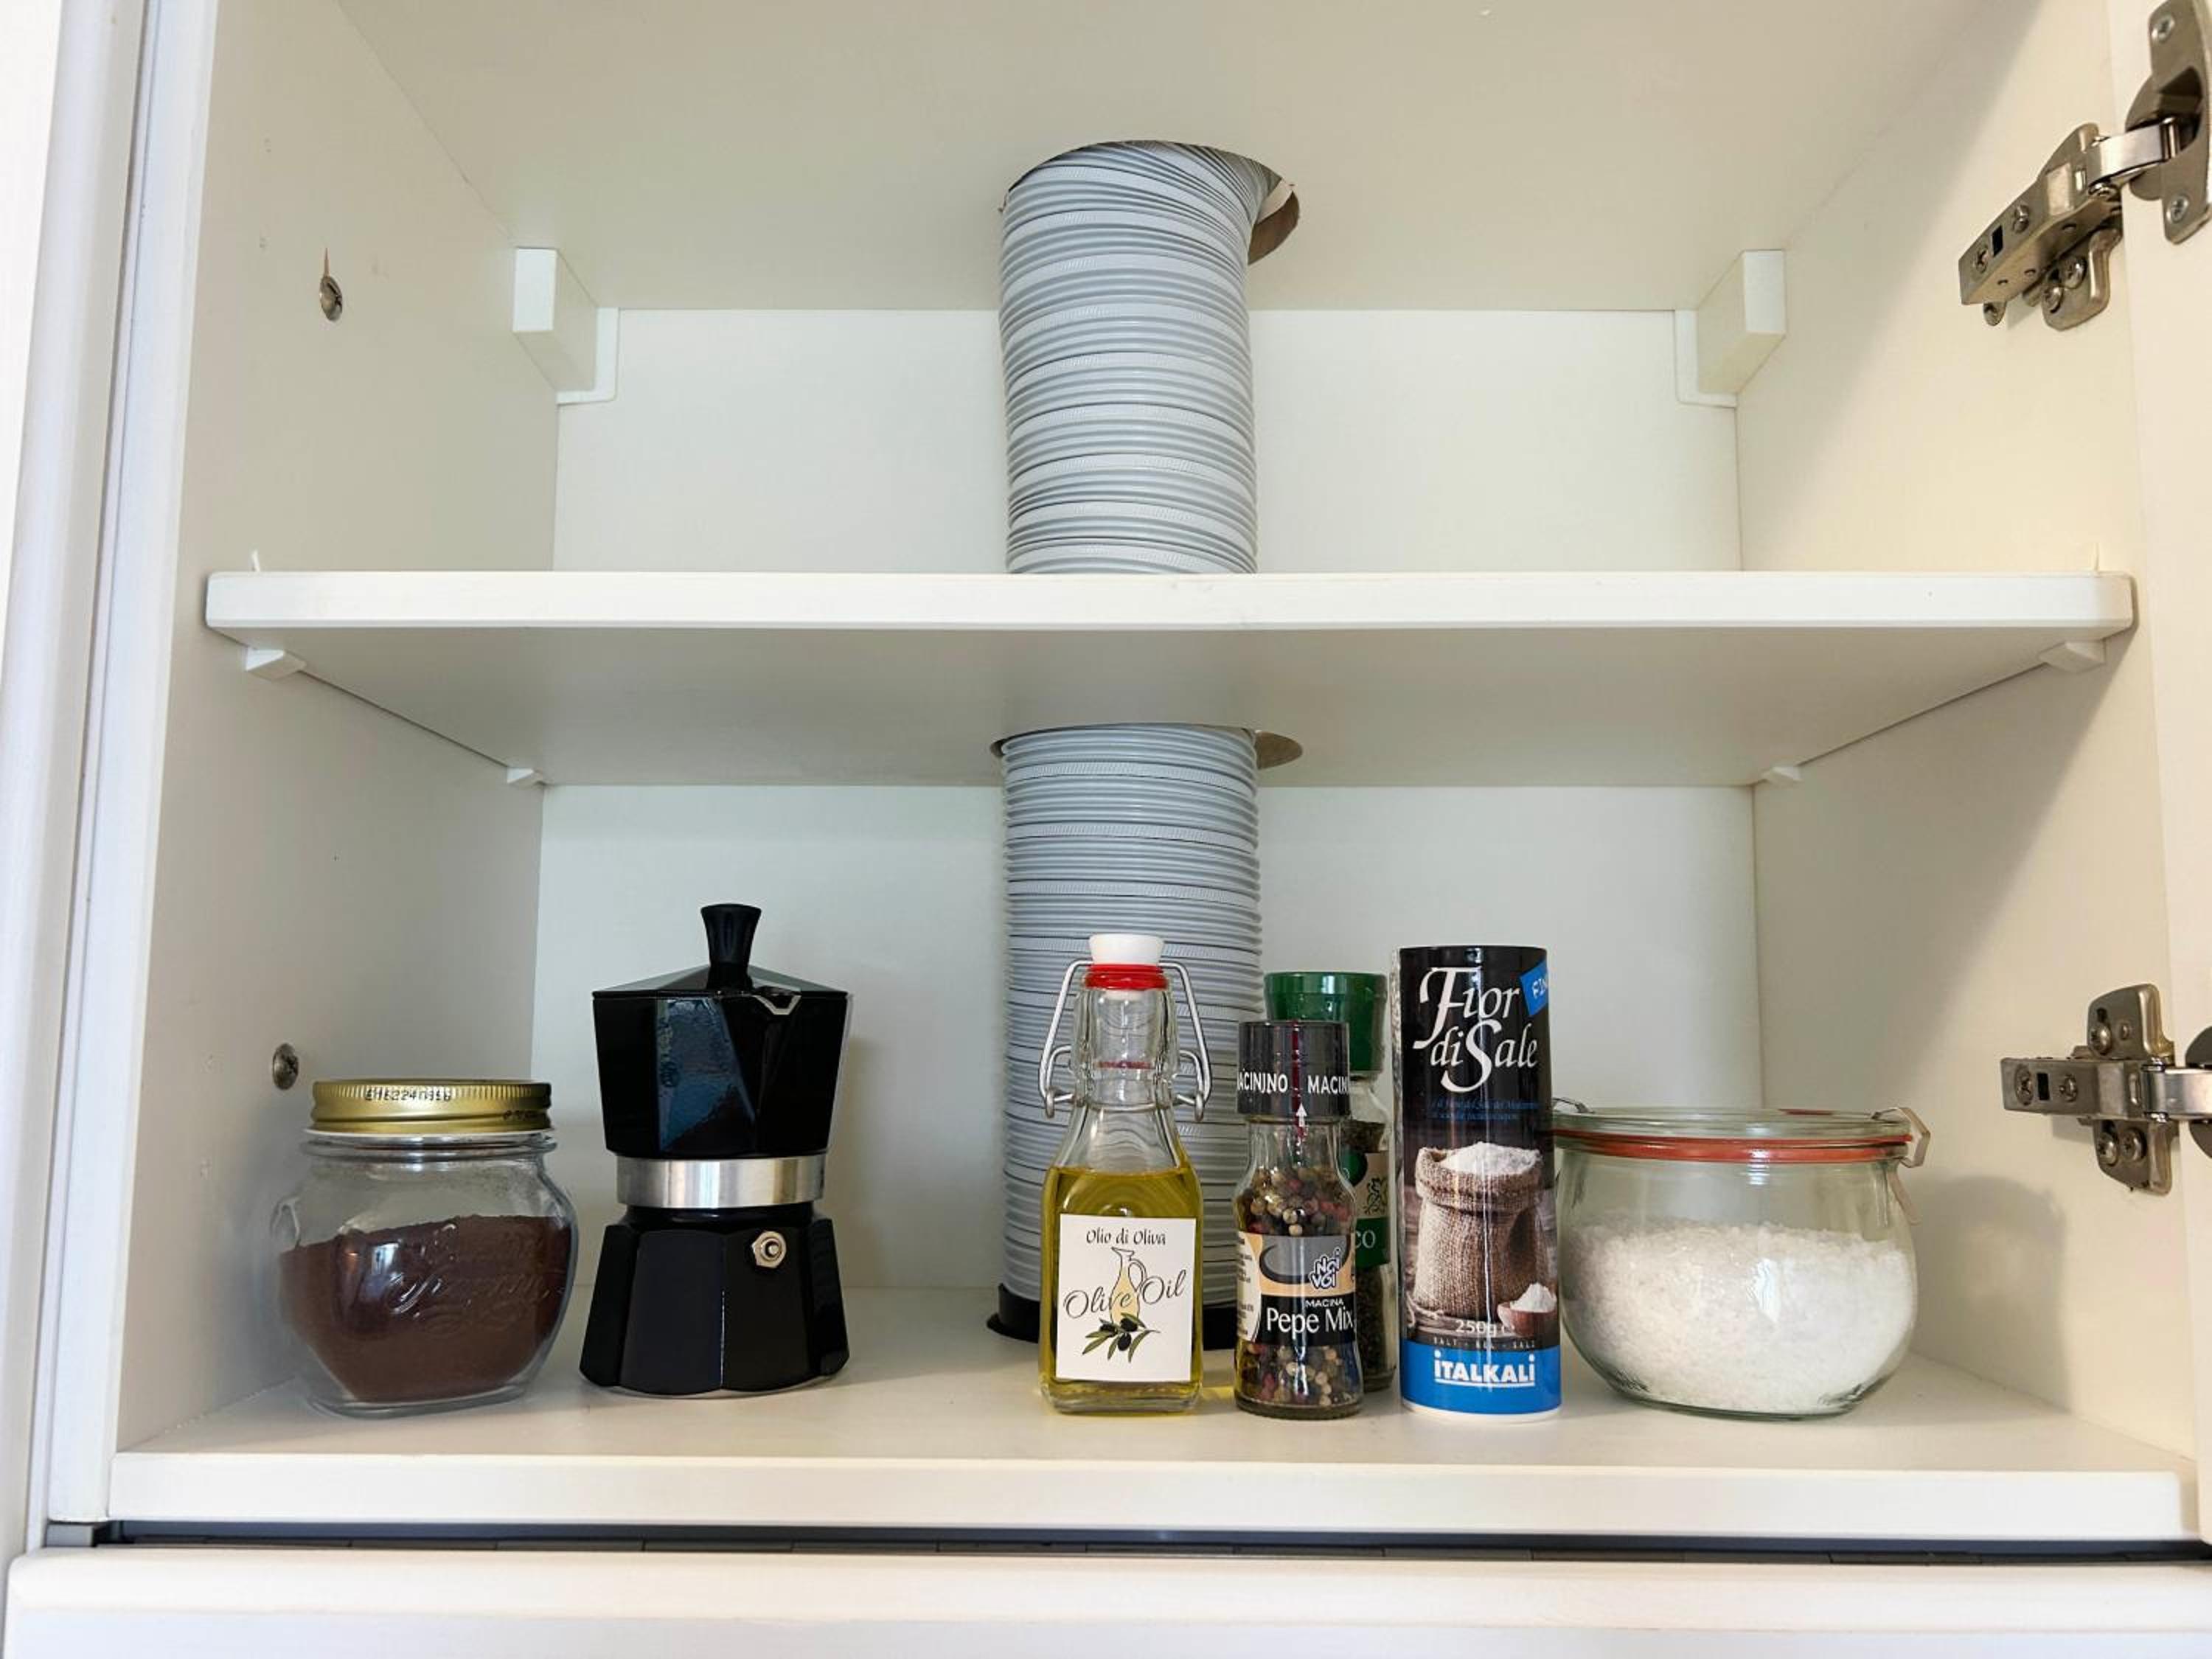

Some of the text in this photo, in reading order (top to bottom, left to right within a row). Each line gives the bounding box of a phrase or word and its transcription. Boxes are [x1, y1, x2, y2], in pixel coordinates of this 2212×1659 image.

[1413, 966, 1520, 1049] Fior
[1430, 1019, 1538, 1093] di Sale
[1307, 1074, 1349, 1095] MACIN
[1086, 1226, 1166, 1245] Olio di Oliva
[1355, 1229, 1377, 1249] CO
[1063, 1269, 1186, 1319] Olive Oil
[1305, 1298, 1344, 1308] MACINA
[1266, 1307, 1320, 1340] Pepe
[1325, 1306, 1353, 1332] Mix
[1455, 1319, 1497, 1338] 250g
